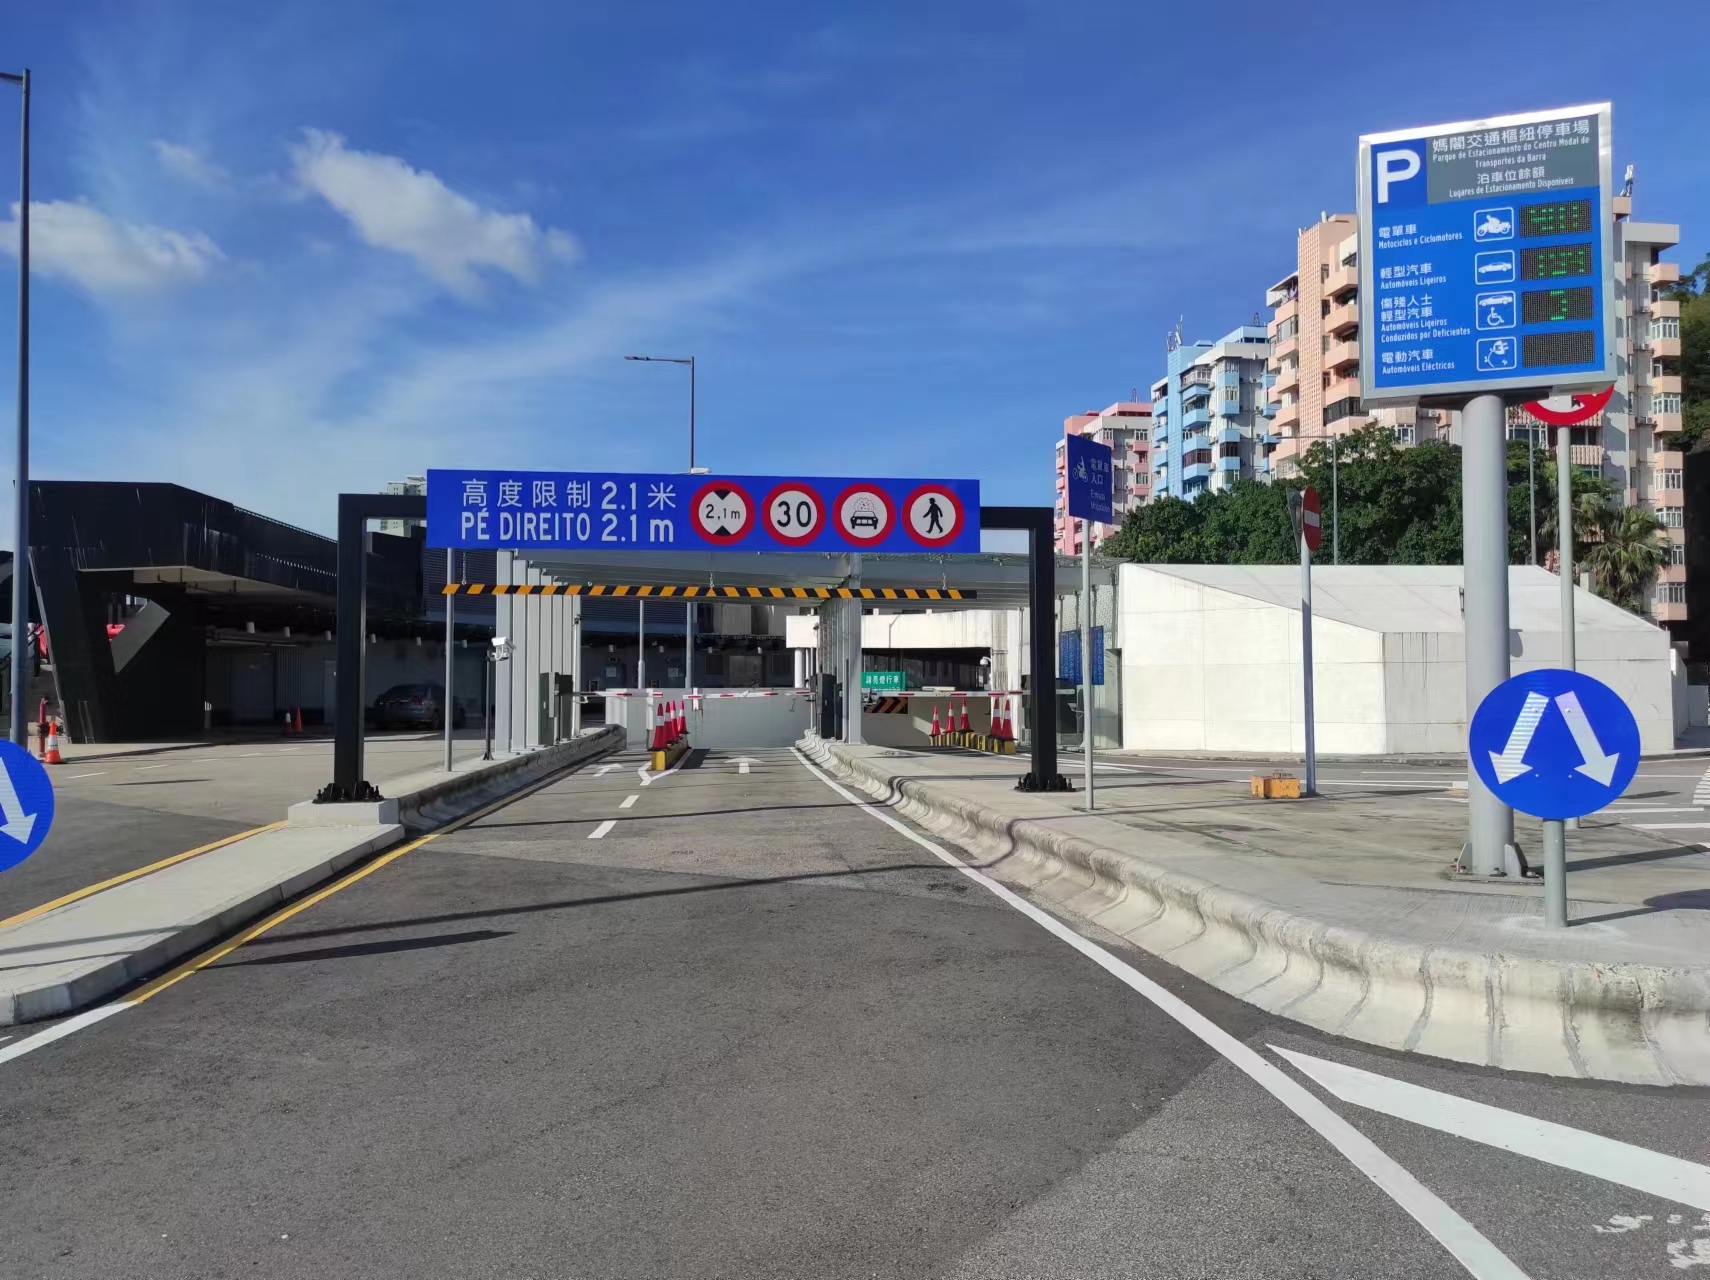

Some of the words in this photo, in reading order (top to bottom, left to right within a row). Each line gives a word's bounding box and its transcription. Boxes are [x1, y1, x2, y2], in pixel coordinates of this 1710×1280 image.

[1432, 120, 1589, 153] 媽閣交通樞紐停車場
[1433, 153, 1456, 163] Parque
[1458, 151, 1466, 159] de
[1468, 144, 1521, 158] Estacionamento
[1523, 142, 1532, 151] do
[1534, 140, 1556, 150] Centro
[1559, 136, 1578, 146] Modal
[1581, 136, 1590, 144] de
[1475, 156, 1514, 168] Transportes
[1517, 154, 1525, 163] da
[1527, 153, 1546, 162] Barra
[1377, 150, 1420, 204] P
[1477, 166, 1544, 185] 泊車位餘額
[1450, 187, 1474, 199] Lugares
[1476, 186, 1484, 194] de
[1486, 179, 1535, 193] Estacionamento
[1379, 224, 1417, 238] 電單車
[1379, 239, 1412, 249] Motociclos
[1420, 232, 1462, 244] Ciclomotores
[1380, 262, 1432, 279] 輕型汽車
[1380, 279, 1418, 289] Automóveis
[1420, 276, 1446, 286] Ligeiros
[1381, 293, 1432, 310] 傷殘人士
[1381, 306, 1432, 322] 輕型汽車
[1381, 321, 1419, 332] Automóveis
[1421, 319, 1447, 329] Ligeiros
[1381, 332, 1418, 342] Conduzidos
[1420, 331, 1430, 341] por
[1433, 327, 1470, 338] Deficientes
[1382, 348, 1433, 364] 電動汽車
[1382, 364, 1420, 374] Automóveis
[1422, 361, 1454, 371] Eléctricos
[462, 479, 591, 508] 高度限制
[601, 481, 637, 510] 2.1
[648, 482, 676, 510] 米
[777, 500, 812, 527] 30
[462, 508, 490, 540] PÉ
[500, 512, 590, 541] DIREITO
[601, 513, 637, 542] 2.1
[650, 518, 674, 542] m
